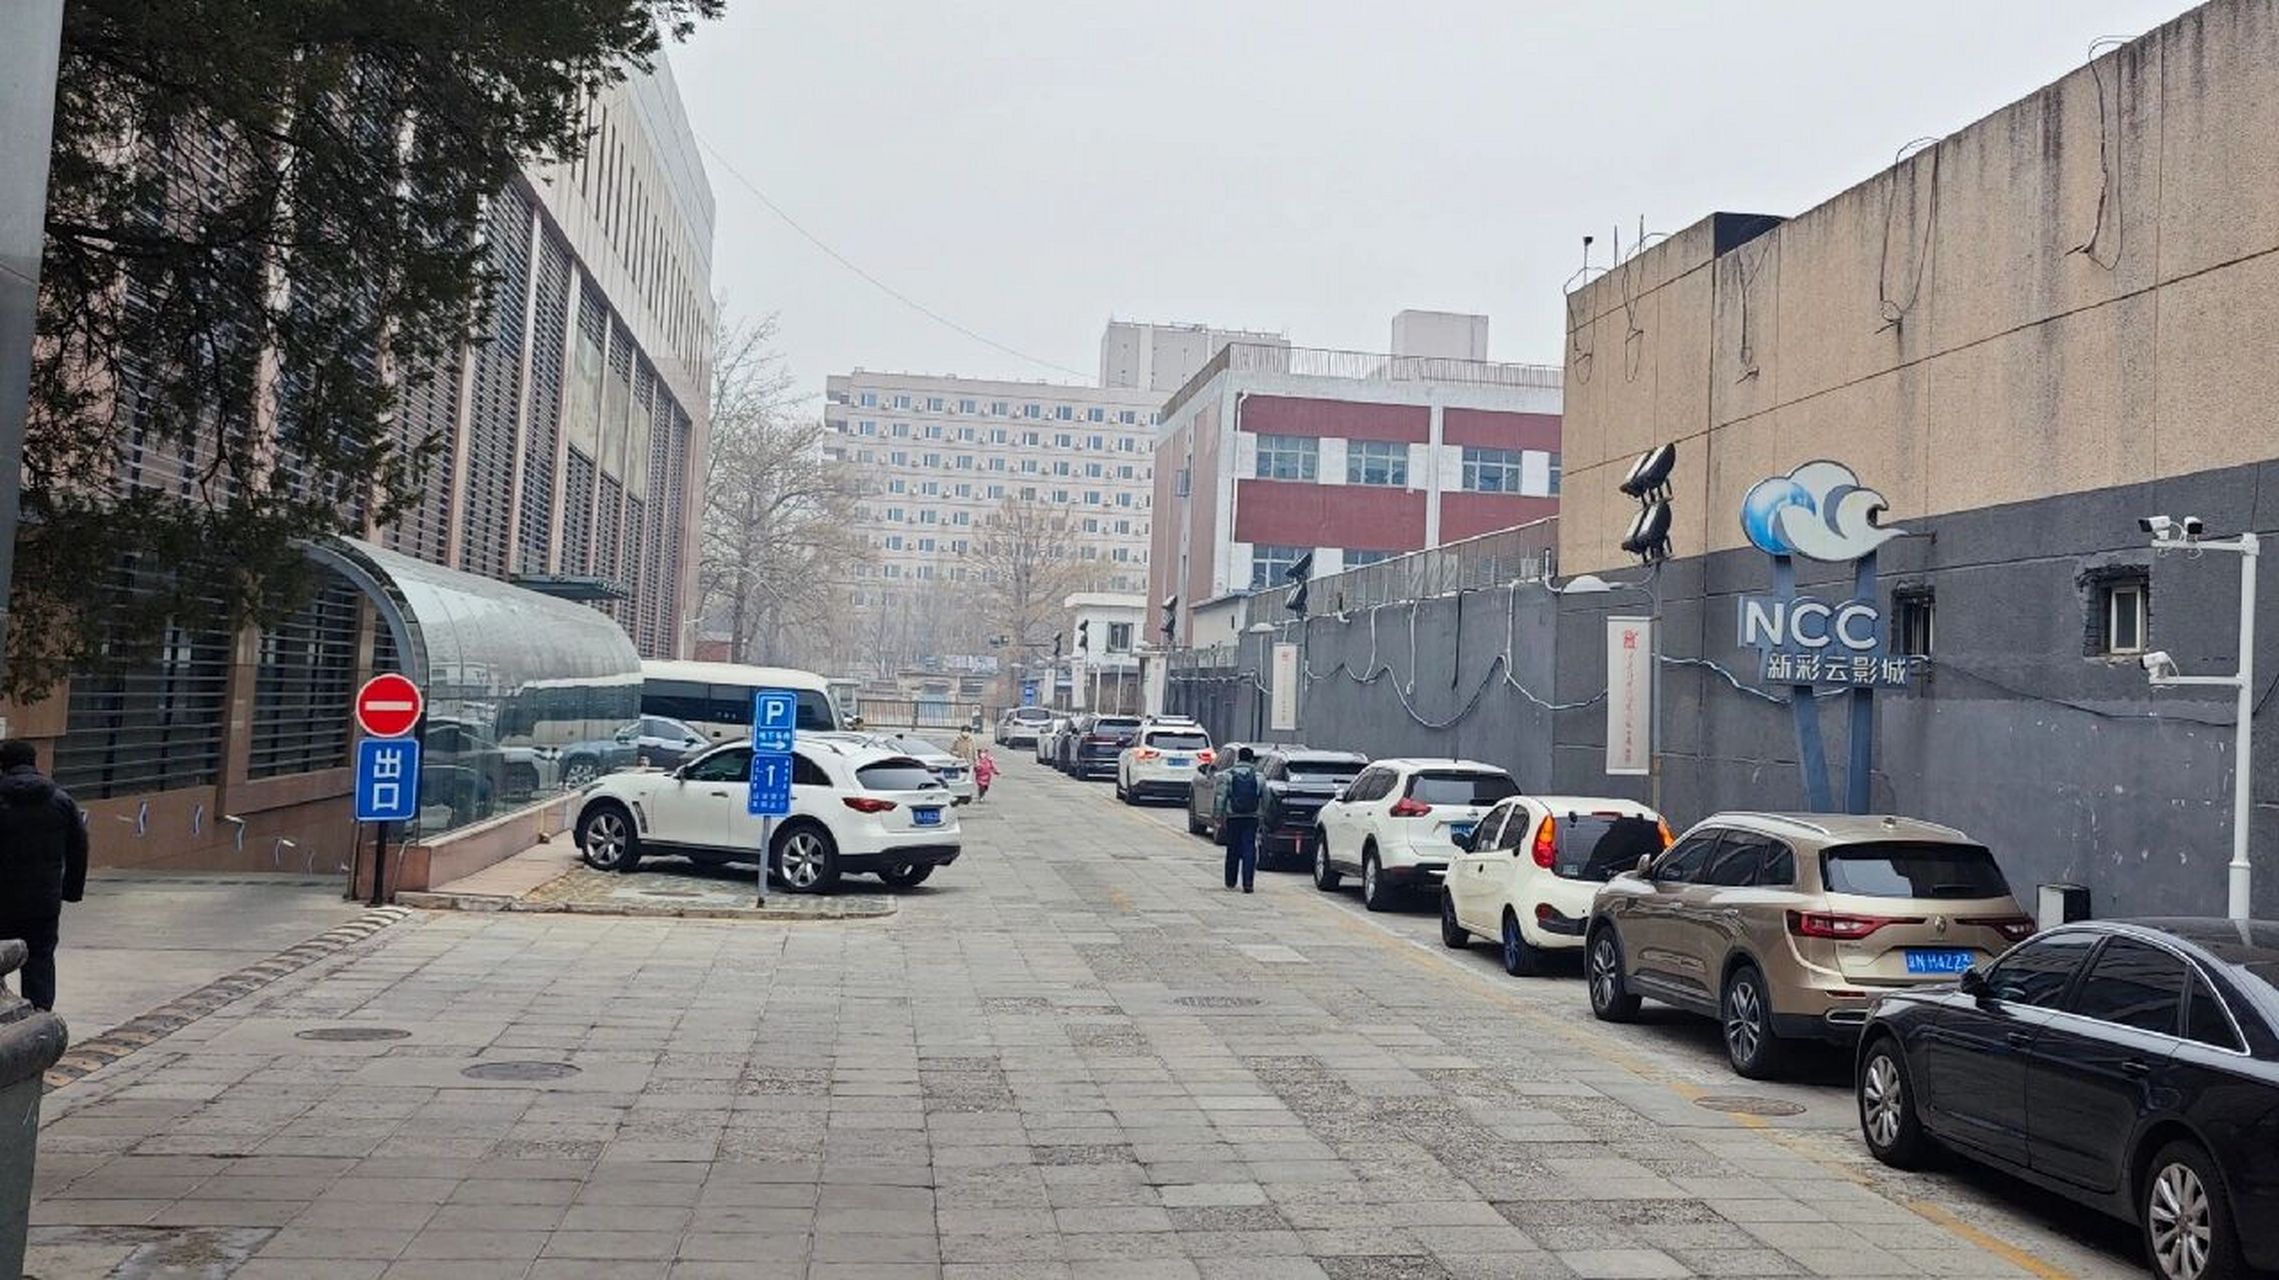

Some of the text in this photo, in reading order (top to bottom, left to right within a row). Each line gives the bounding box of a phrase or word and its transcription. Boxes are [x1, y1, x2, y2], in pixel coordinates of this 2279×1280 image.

[1746, 601, 1878, 649] NCC
[1767, 653, 1906, 685] 新彩云影城
[766, 701, 784, 724] P
[373, 748, 402, 811] 出口
